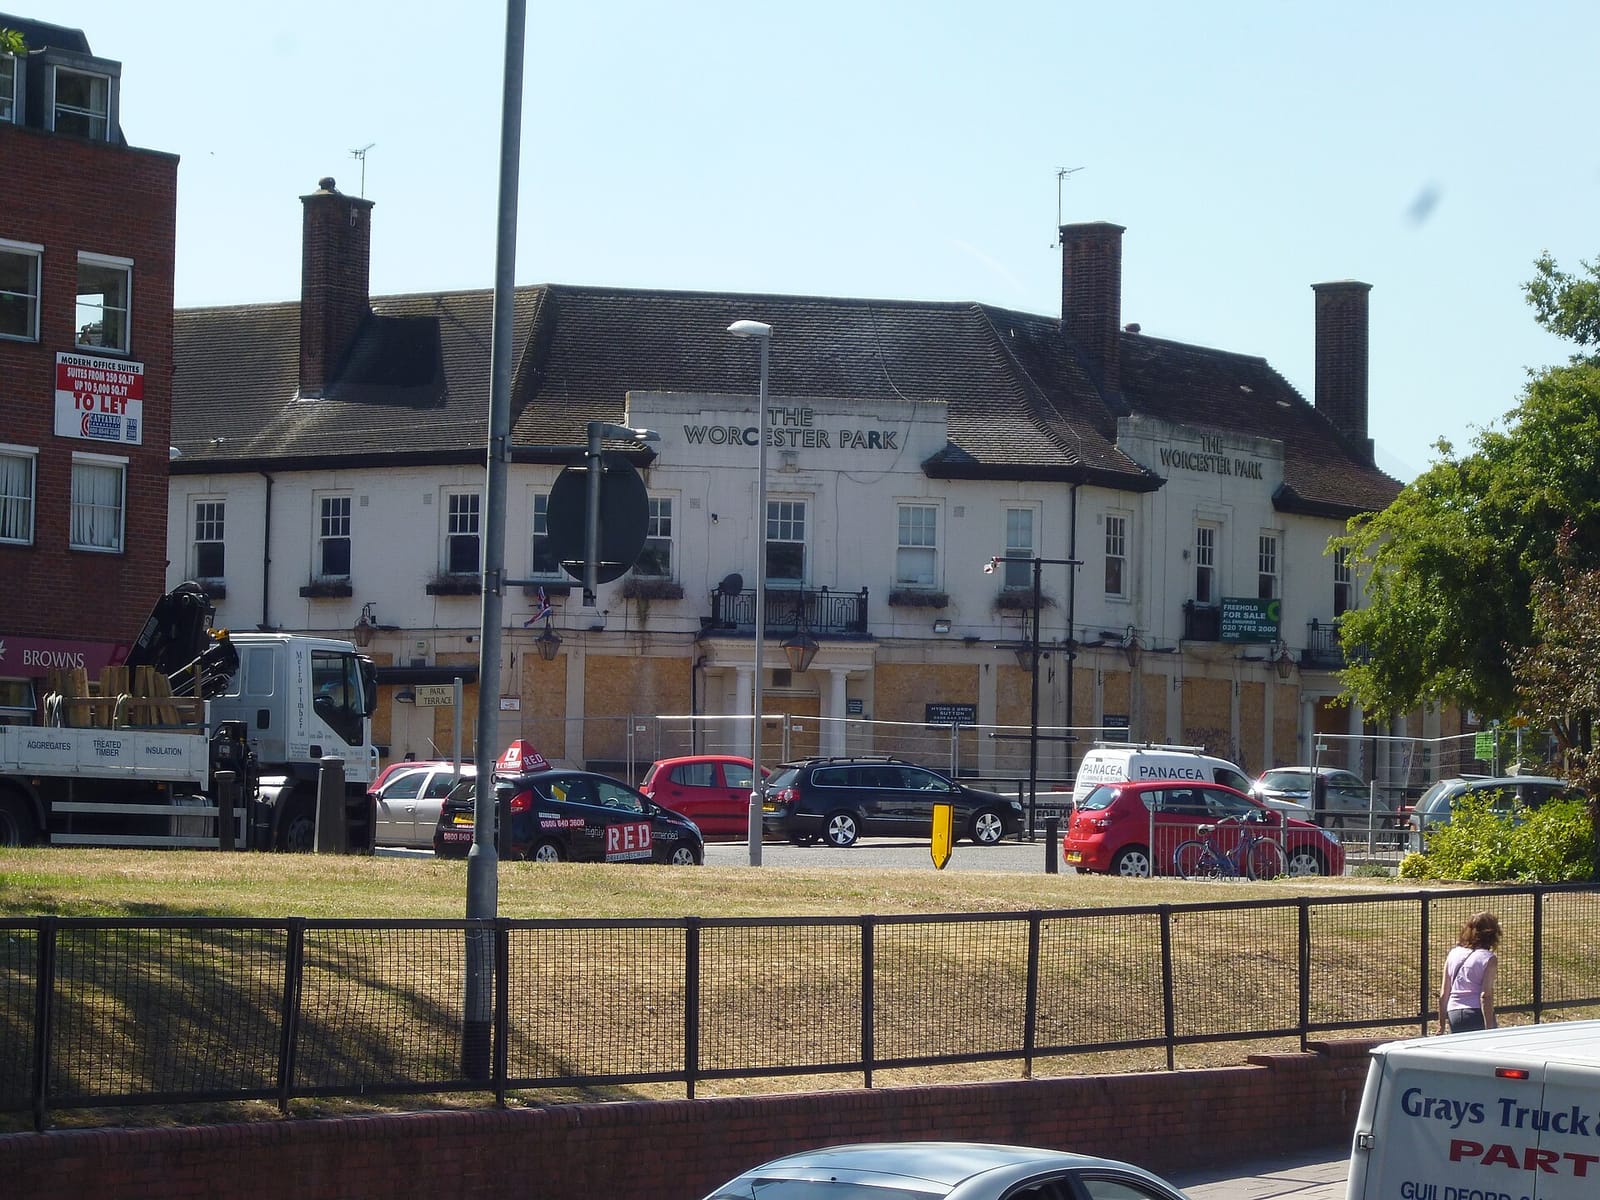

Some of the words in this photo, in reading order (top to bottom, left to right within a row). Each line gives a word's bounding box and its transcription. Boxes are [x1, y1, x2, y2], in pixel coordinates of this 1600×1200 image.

[61, 355, 91, 366] MODERN
[93, 360, 116, 371] OFFICE
[118, 363, 140, 373] SUITES
[67, 367, 87, 378] SUITES
[88, 370, 105, 381] FROM
[106, 372, 118, 383] 250
[75, 380, 83, 391] UP
[84, 382, 92, 391] TO
[93, 383, 110, 394] 5,000
[73, 391, 95, 411] TO
[100, 395, 128, 415] LET
[767, 407, 814, 427] THE
[840, 429, 898, 450] PARK
[1200, 433, 1223, 454] THE
[1160, 447, 1231, 475] WORCESTER
[1234, 459, 1263, 480] PARK
[1223, 611, 1241, 619] FOR
[1243, 612, 1266, 620] SALE
[23, 649, 85, 668] BROWNS
[430, 687, 445, 695] PARK
[424, 697, 452, 705] TERRACE
[27, 740, 72, 751] AGGREGATES
[93, 740, 122, 749] TREATED
[145, 746, 182, 757] INSULATION
[95, 748, 120, 757] TIMBER
[523, 753, 543, 766] RED
[1083, 764, 1122, 776] PANACEA
[1140, 766, 1204, 780] PANACEA
[585, 826, 605, 838] highly
[608, 824, 650, 851] RED
[1401, 1087, 1485, 1129] Grays
[1498, 1098, 1590, 1136] Truck
[1449, 1139, 1600, 1177] PART
